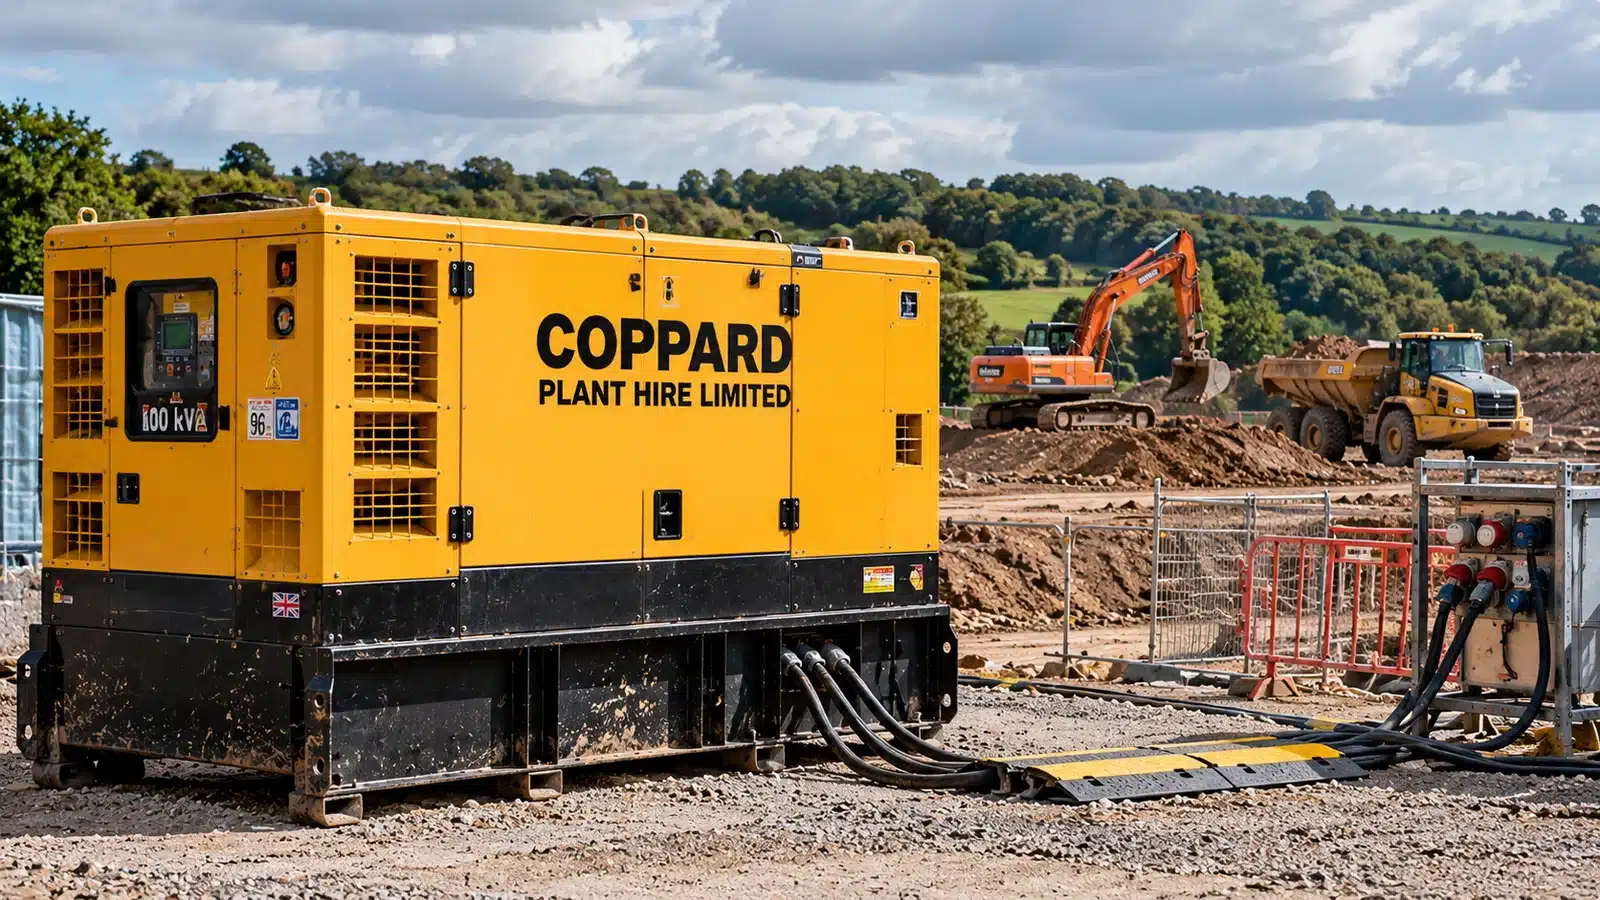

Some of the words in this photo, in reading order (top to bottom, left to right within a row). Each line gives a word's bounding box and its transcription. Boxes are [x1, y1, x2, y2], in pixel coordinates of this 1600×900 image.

[537, 313, 793, 373] COPPARD
[539, 379, 626, 406] PLANT
[634, 381, 692, 407] HIRE
[700, 382, 792, 408] LIMITED
[250, 412, 266, 436] 96
